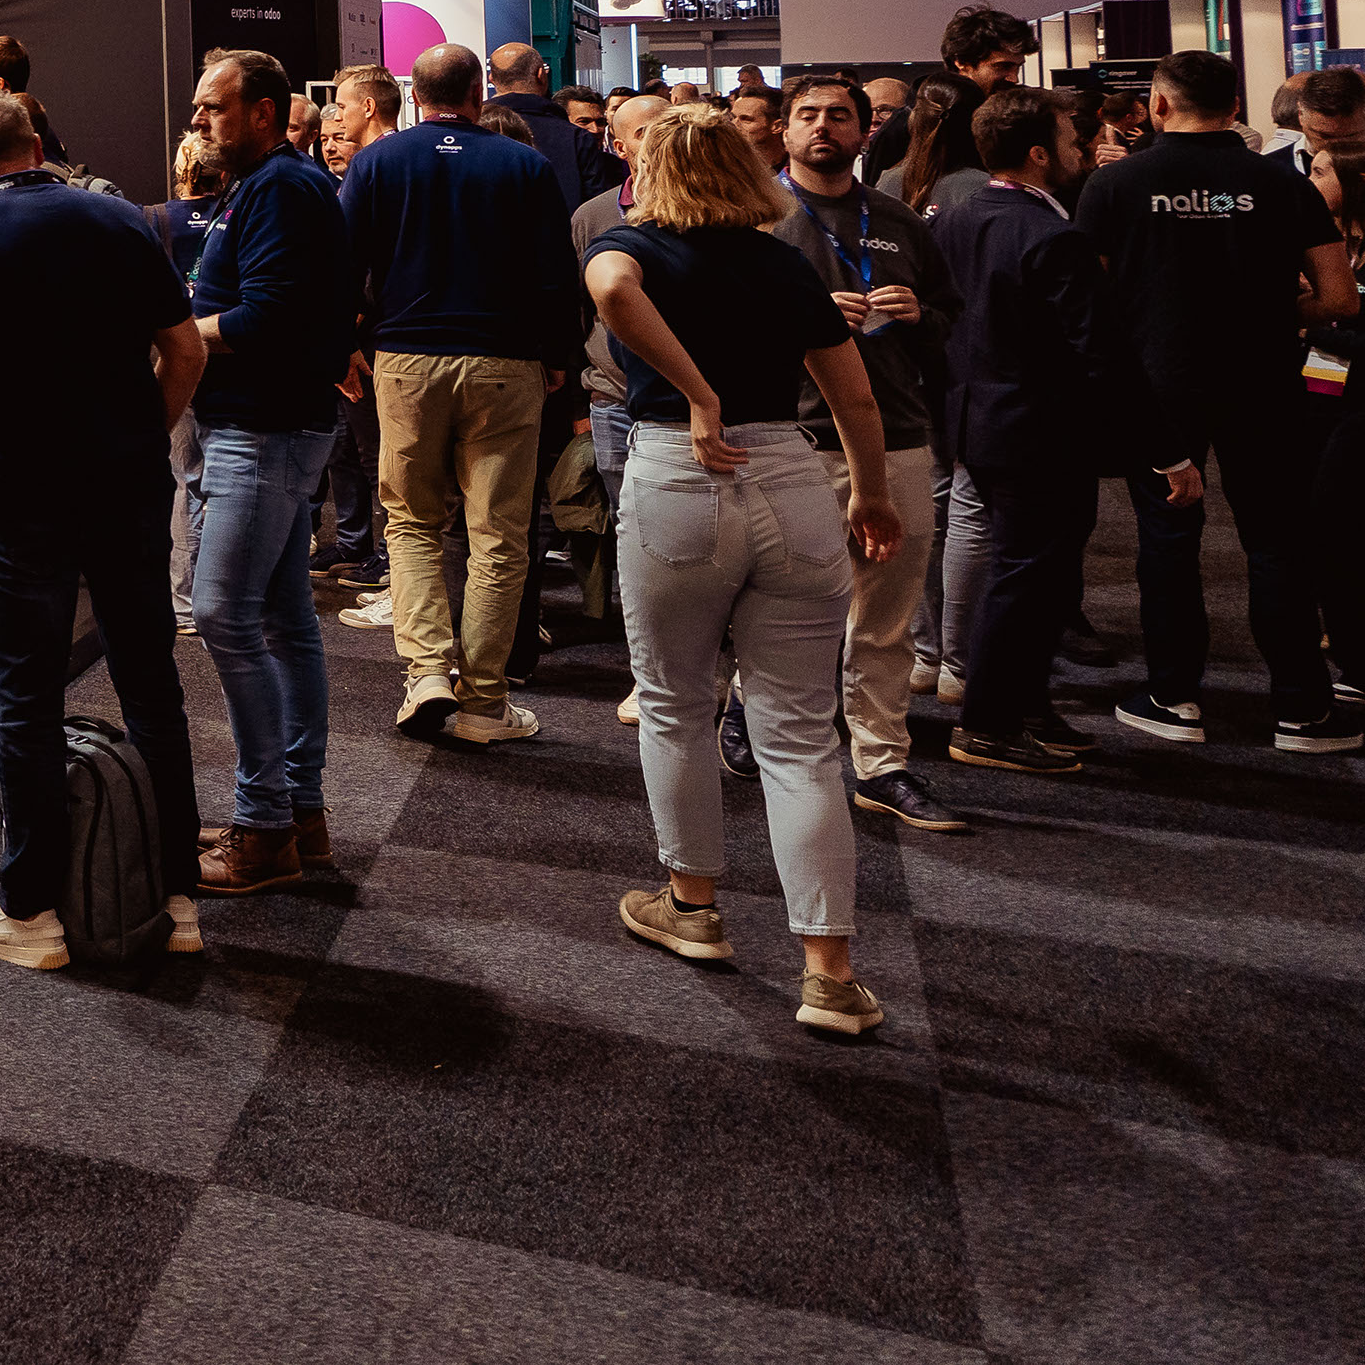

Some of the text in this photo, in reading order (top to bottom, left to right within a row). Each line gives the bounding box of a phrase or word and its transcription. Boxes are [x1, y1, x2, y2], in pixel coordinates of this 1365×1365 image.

[231, 6, 282, 21] experts in odoo
[1150, 188, 1255, 213] nalios
